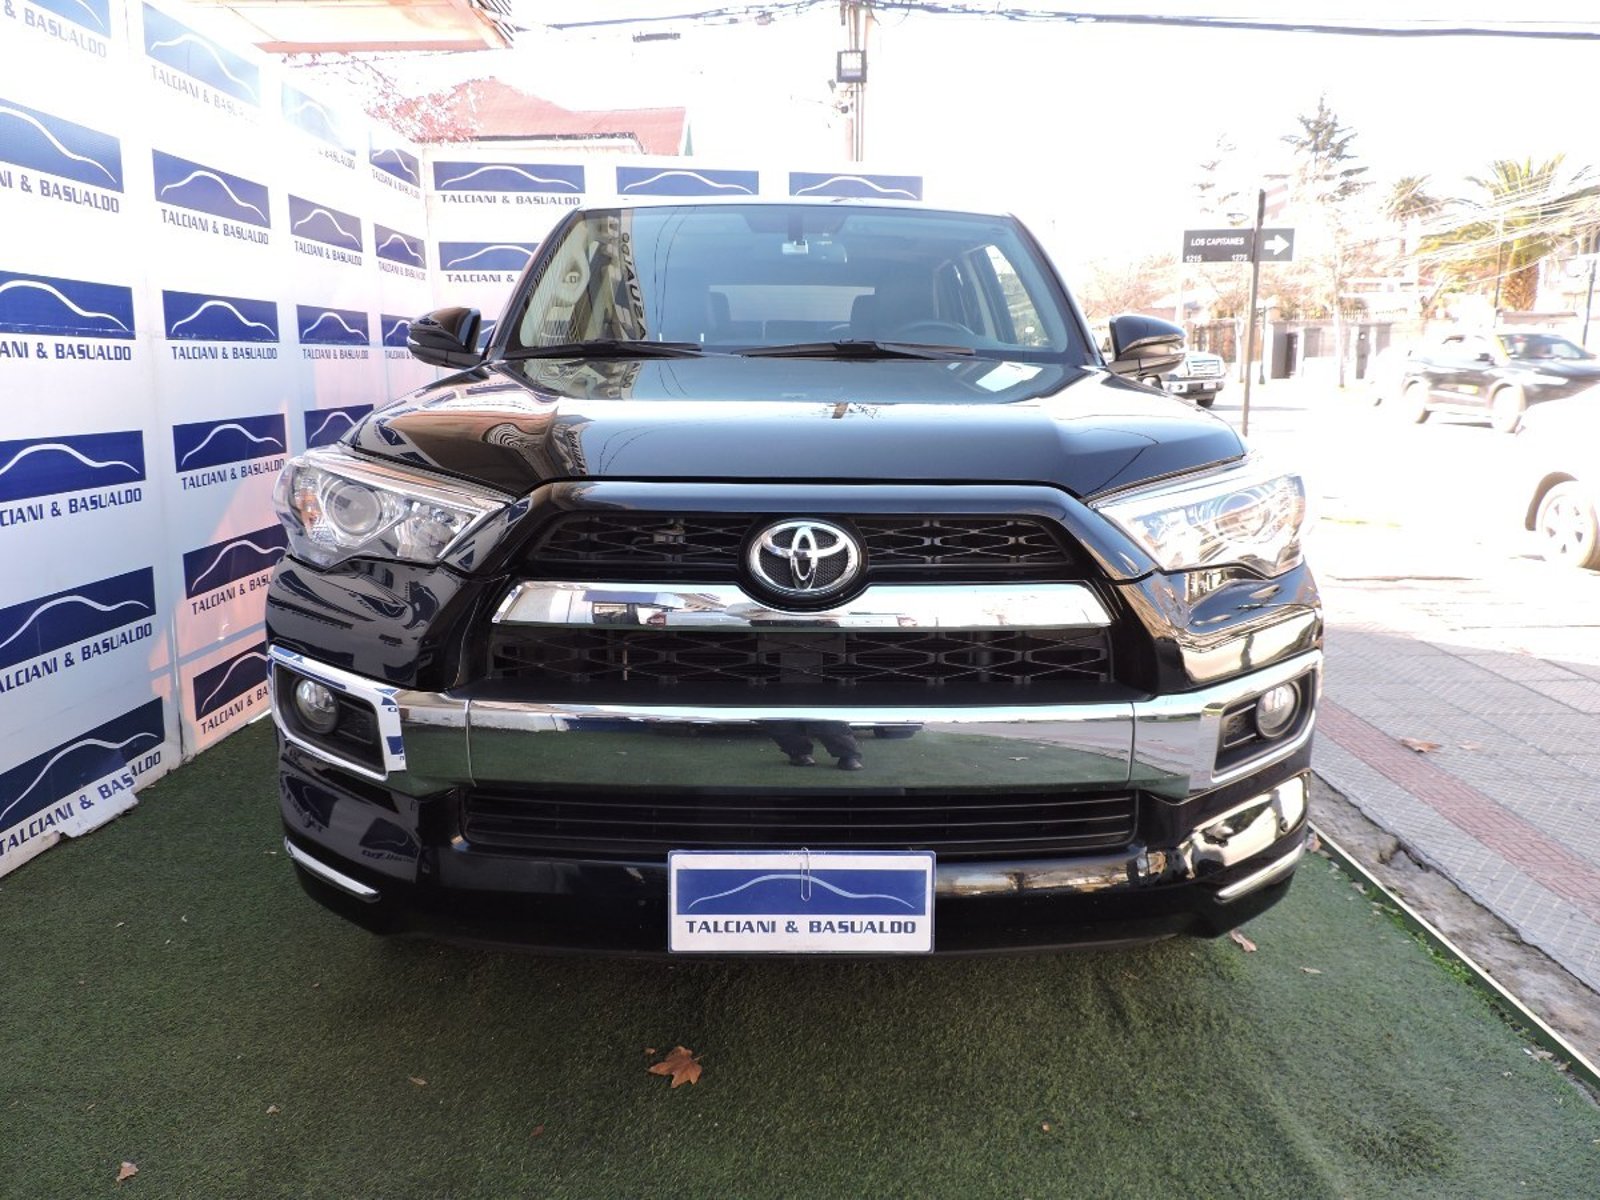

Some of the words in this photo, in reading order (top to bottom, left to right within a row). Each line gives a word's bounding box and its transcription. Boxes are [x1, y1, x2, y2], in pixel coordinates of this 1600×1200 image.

[24, 8, 107, 58] BASUALDO
[20, 174, 33, 193] &
[40, 178, 119, 214] BASUALDO
[441, 194, 497, 204] TALCIANI
[502, 195, 511, 204] &
[516, 195, 581, 206] BASUALDO
[161, 208, 209, 232] TALCIANI
[212, 221, 220, 235] &
[223, 223, 269, 246] BASUALDO
[294, 241, 324, 258] TALCIANI
[1190, 237, 1206, 247] LOS
[446, 273, 501, 283] TALCIANI
[506, 274, 515, 283] &
[36, 342, 48, 359] &
[55, 343, 131, 361] BASUALDO
[171, 346, 218, 360] TALCIANI
[221, 347, 229, 360] &
[232, 347, 278, 360] BASUALDO
[181, 469, 227, 490] TALCIANI
[230, 467, 238, 480] &
[240, 458, 285, 478] BASUALDO
[51, 501, 62, 517] &
[68, 487, 142, 514] BASUALDO
[191, 586, 236, 615] TALCIANI
[239, 583, 246, 595] &
[64, 651, 75, 668] &
[81, 622, 153, 661] BASUALDO
[201, 699, 245, 734] TALCIANI
[246, 694, 254, 707] &
[78, 794, 95, 811] &
[686, 920, 777, 934] TALCIANI
[785, 921, 799, 934] &
[808, 920, 917, 934] BASUALDO
